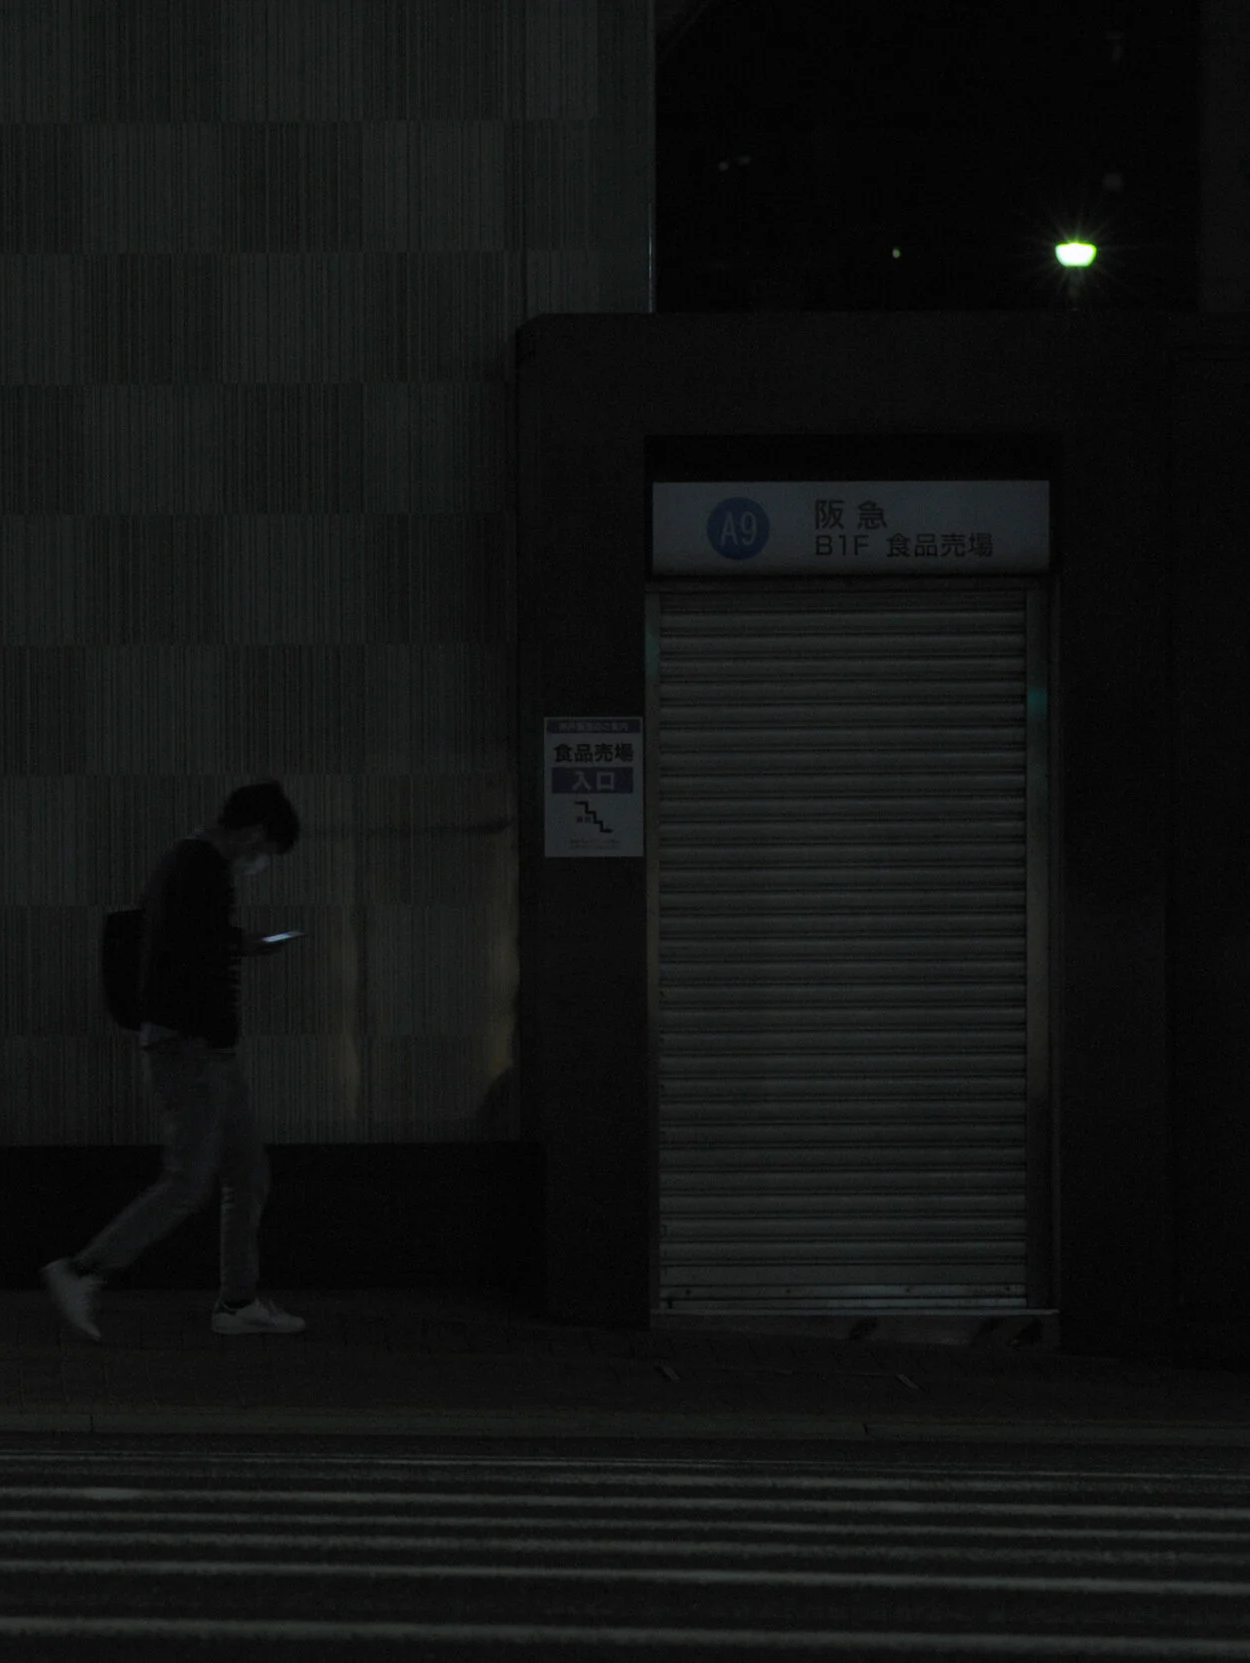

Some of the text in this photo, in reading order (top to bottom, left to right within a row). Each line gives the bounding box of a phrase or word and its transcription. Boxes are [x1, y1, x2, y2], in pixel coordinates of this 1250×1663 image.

[814, 499, 888, 530] 阪急
[718, 510, 759, 548] A9
[815, 532, 994, 559] B1F 食品売場
[553, 743, 634, 763] 食品売場
[571, 770, 616, 791] 入口
